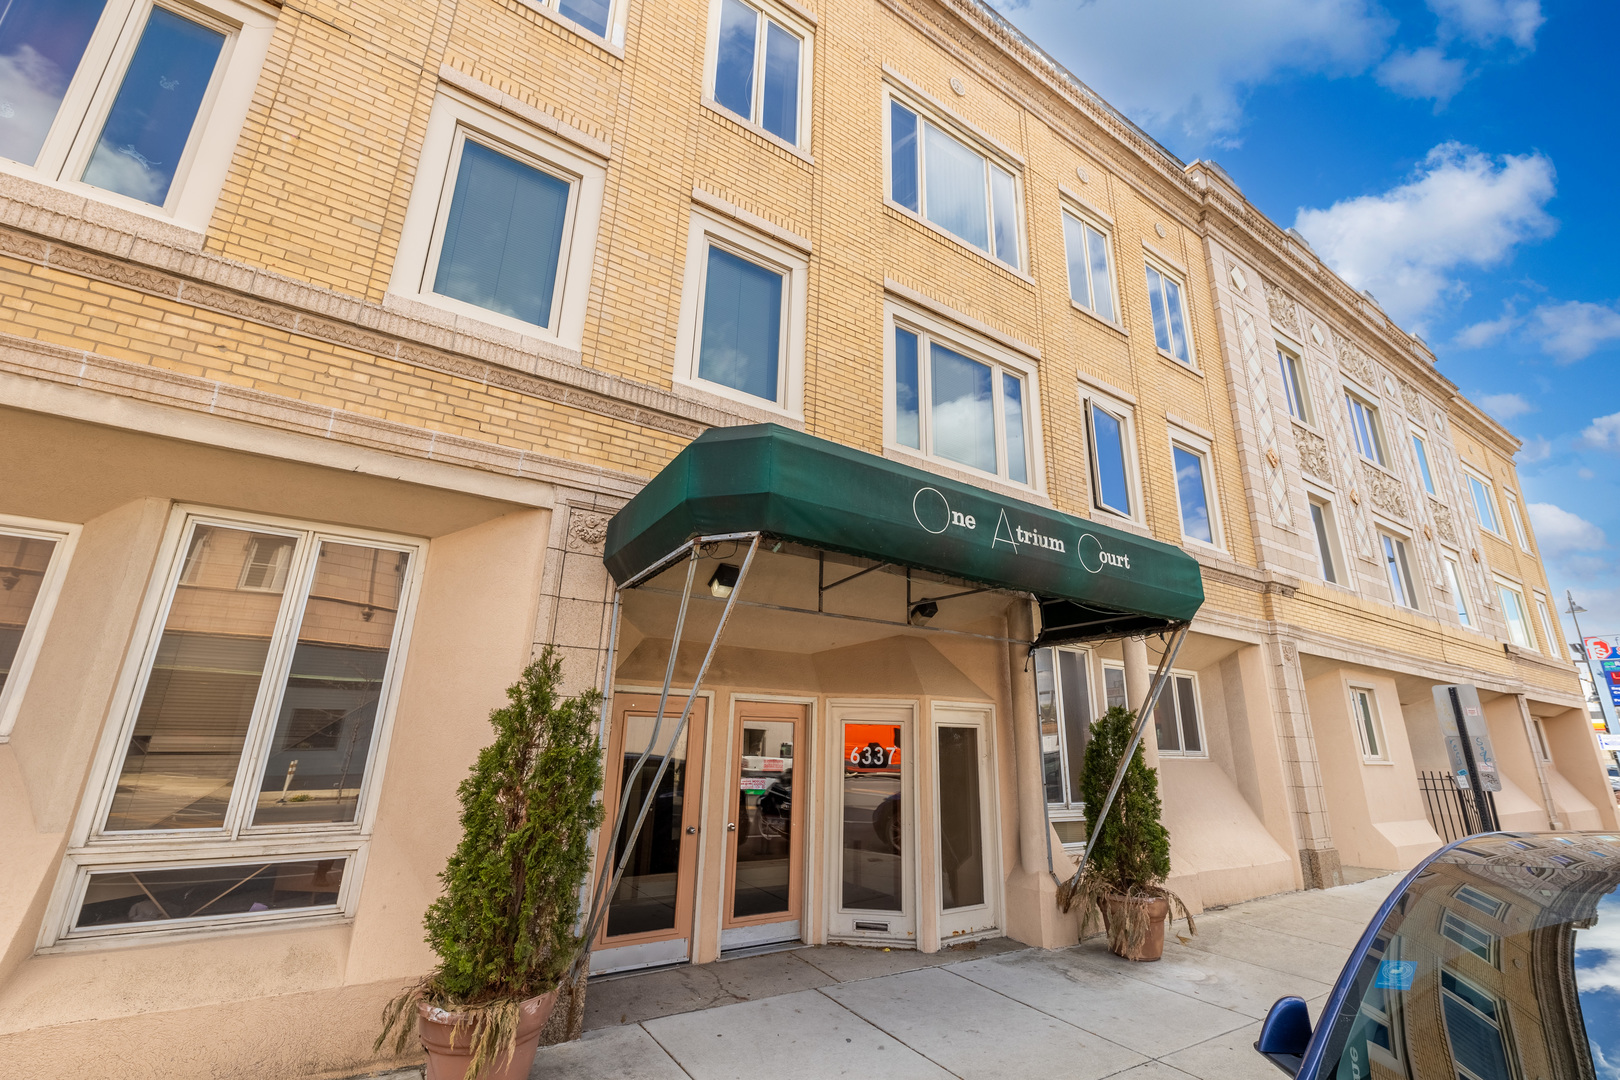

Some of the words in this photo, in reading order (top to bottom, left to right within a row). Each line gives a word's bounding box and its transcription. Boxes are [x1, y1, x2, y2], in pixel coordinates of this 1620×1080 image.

[912, 487, 976, 534] One
[991, 508, 1066, 555] Atrium
[1078, 533, 1131, 574] Court
[850, 746, 896, 765] 6337
